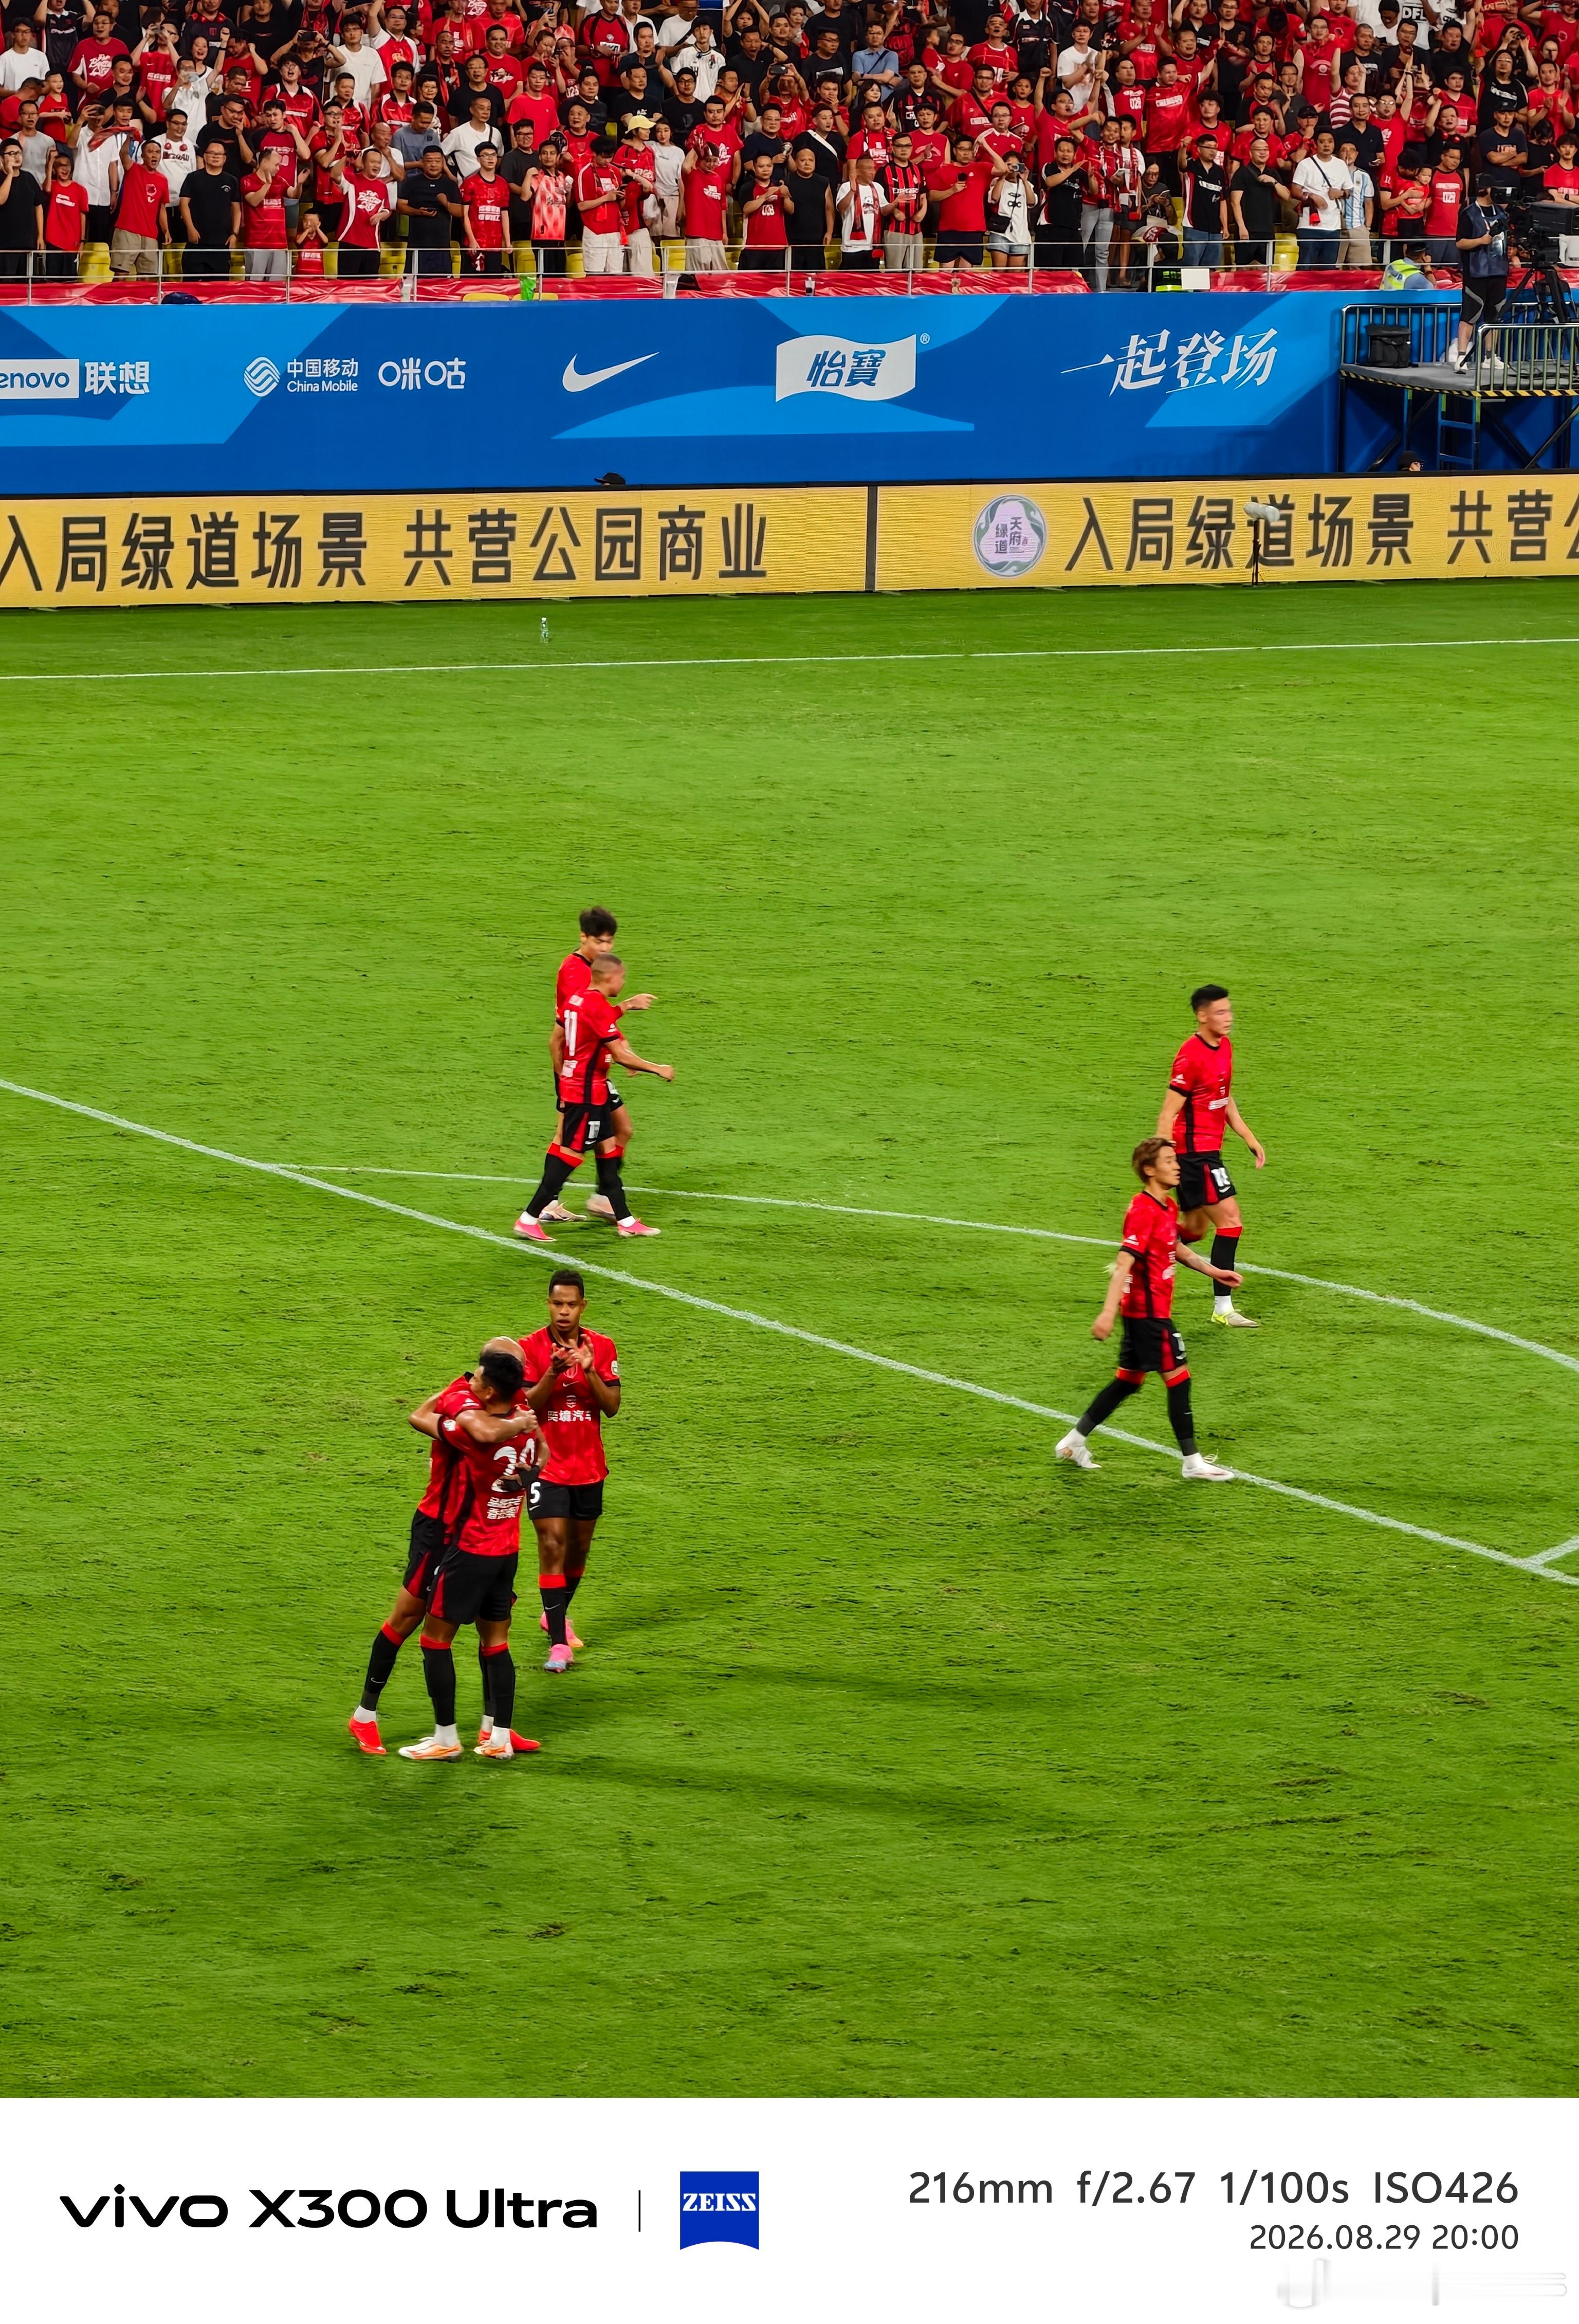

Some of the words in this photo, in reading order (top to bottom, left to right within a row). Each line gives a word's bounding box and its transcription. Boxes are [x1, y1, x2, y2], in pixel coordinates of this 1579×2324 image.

[85, 361, 150, 395] 联想
[287, 358, 358, 378] 中国移动
[379, 357, 466, 390] 咪咕
[806, 349, 887, 387] 怡寶
[1061, 328, 1278, 396] 一起登场
[287, 380, 319, 392] China
[322, 379, 358, 392] Mobile
[0, 512, 367, 592] 入局绿道场景
[403, 503, 767, 586] 共营公园商业
[1065, 494, 1414, 572] 入局绿道场景
[530, 1481, 541, 1504] 5
